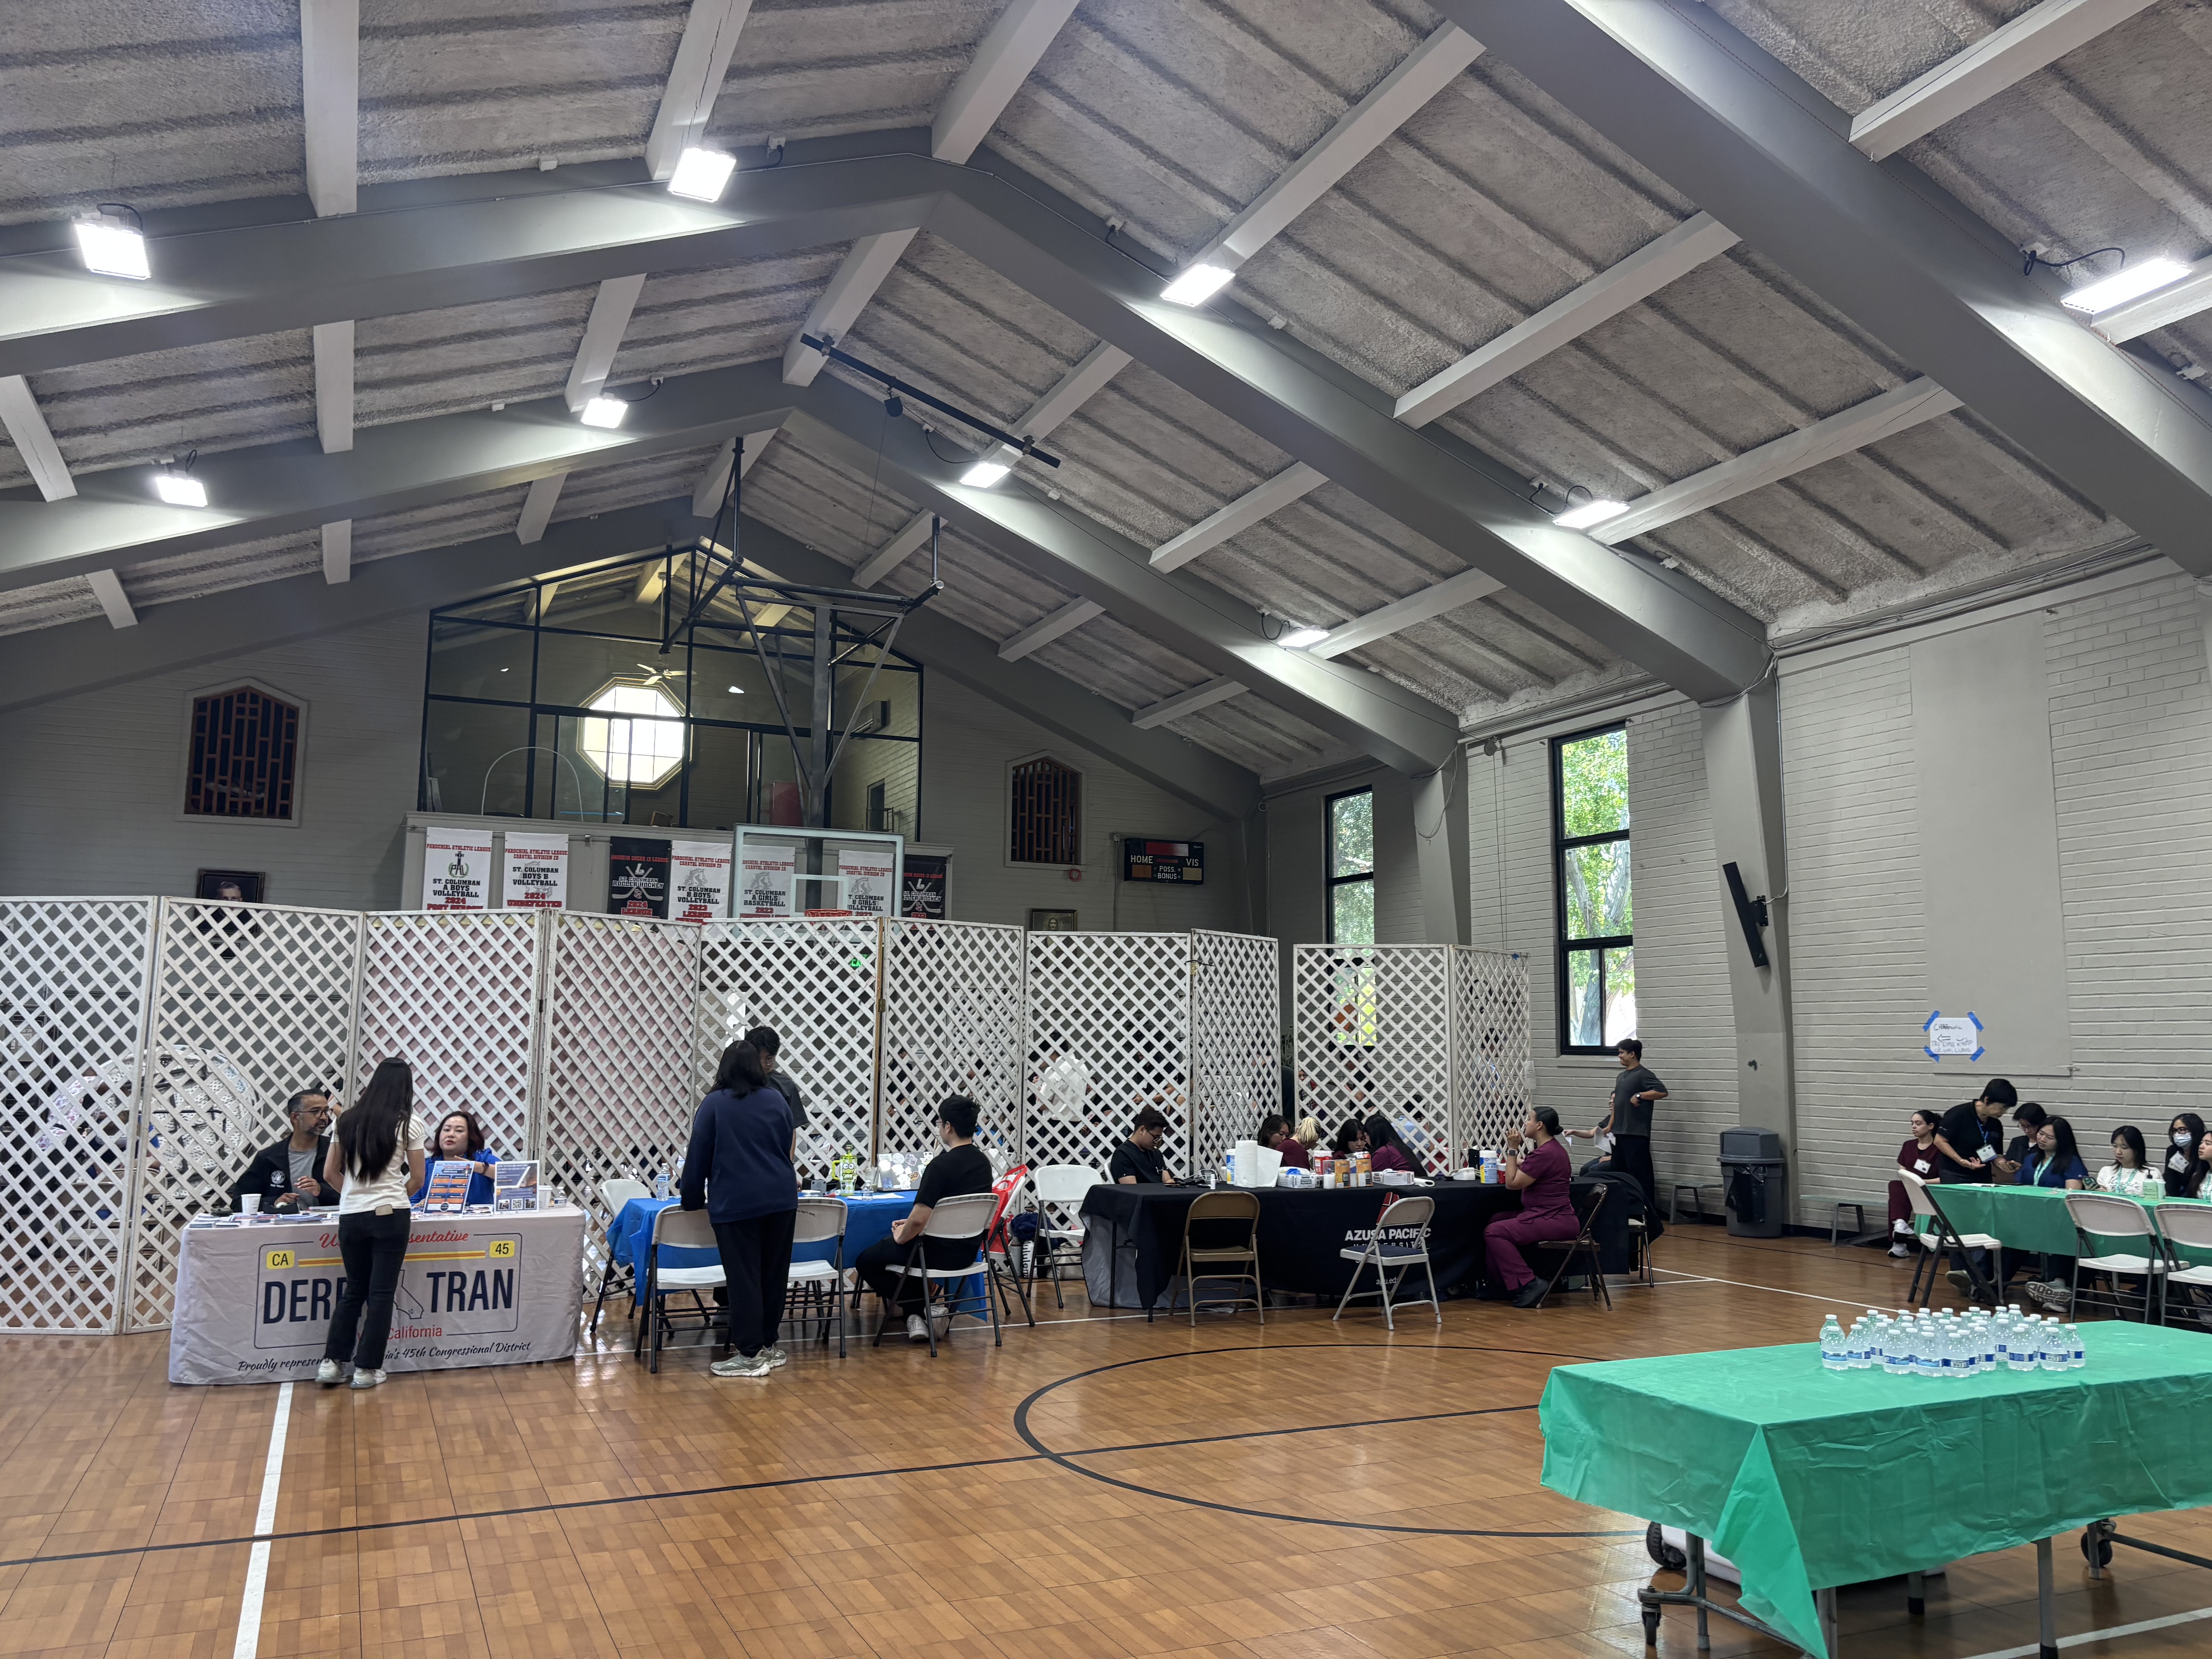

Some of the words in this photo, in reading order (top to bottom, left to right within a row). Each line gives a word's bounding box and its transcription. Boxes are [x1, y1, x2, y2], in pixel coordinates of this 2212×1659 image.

[1131, 855, 1153, 864] HOME
[408, 1230, 469, 1243] sentative
[1345, 1229, 1386, 1241] AZUSA
[1389, 1228, 1431, 1239] PACIFC
[272, 1254, 289, 1266] CA
[495, 1243, 509, 1255] 45
[426, 1269, 514, 1312] TRAN
[238, 1358, 278, 1373] Proudly
[402, 1345, 426, 1358] 45th
[429, 1343, 495, 1359] Congressional
[496, 1341, 531, 1353] District
